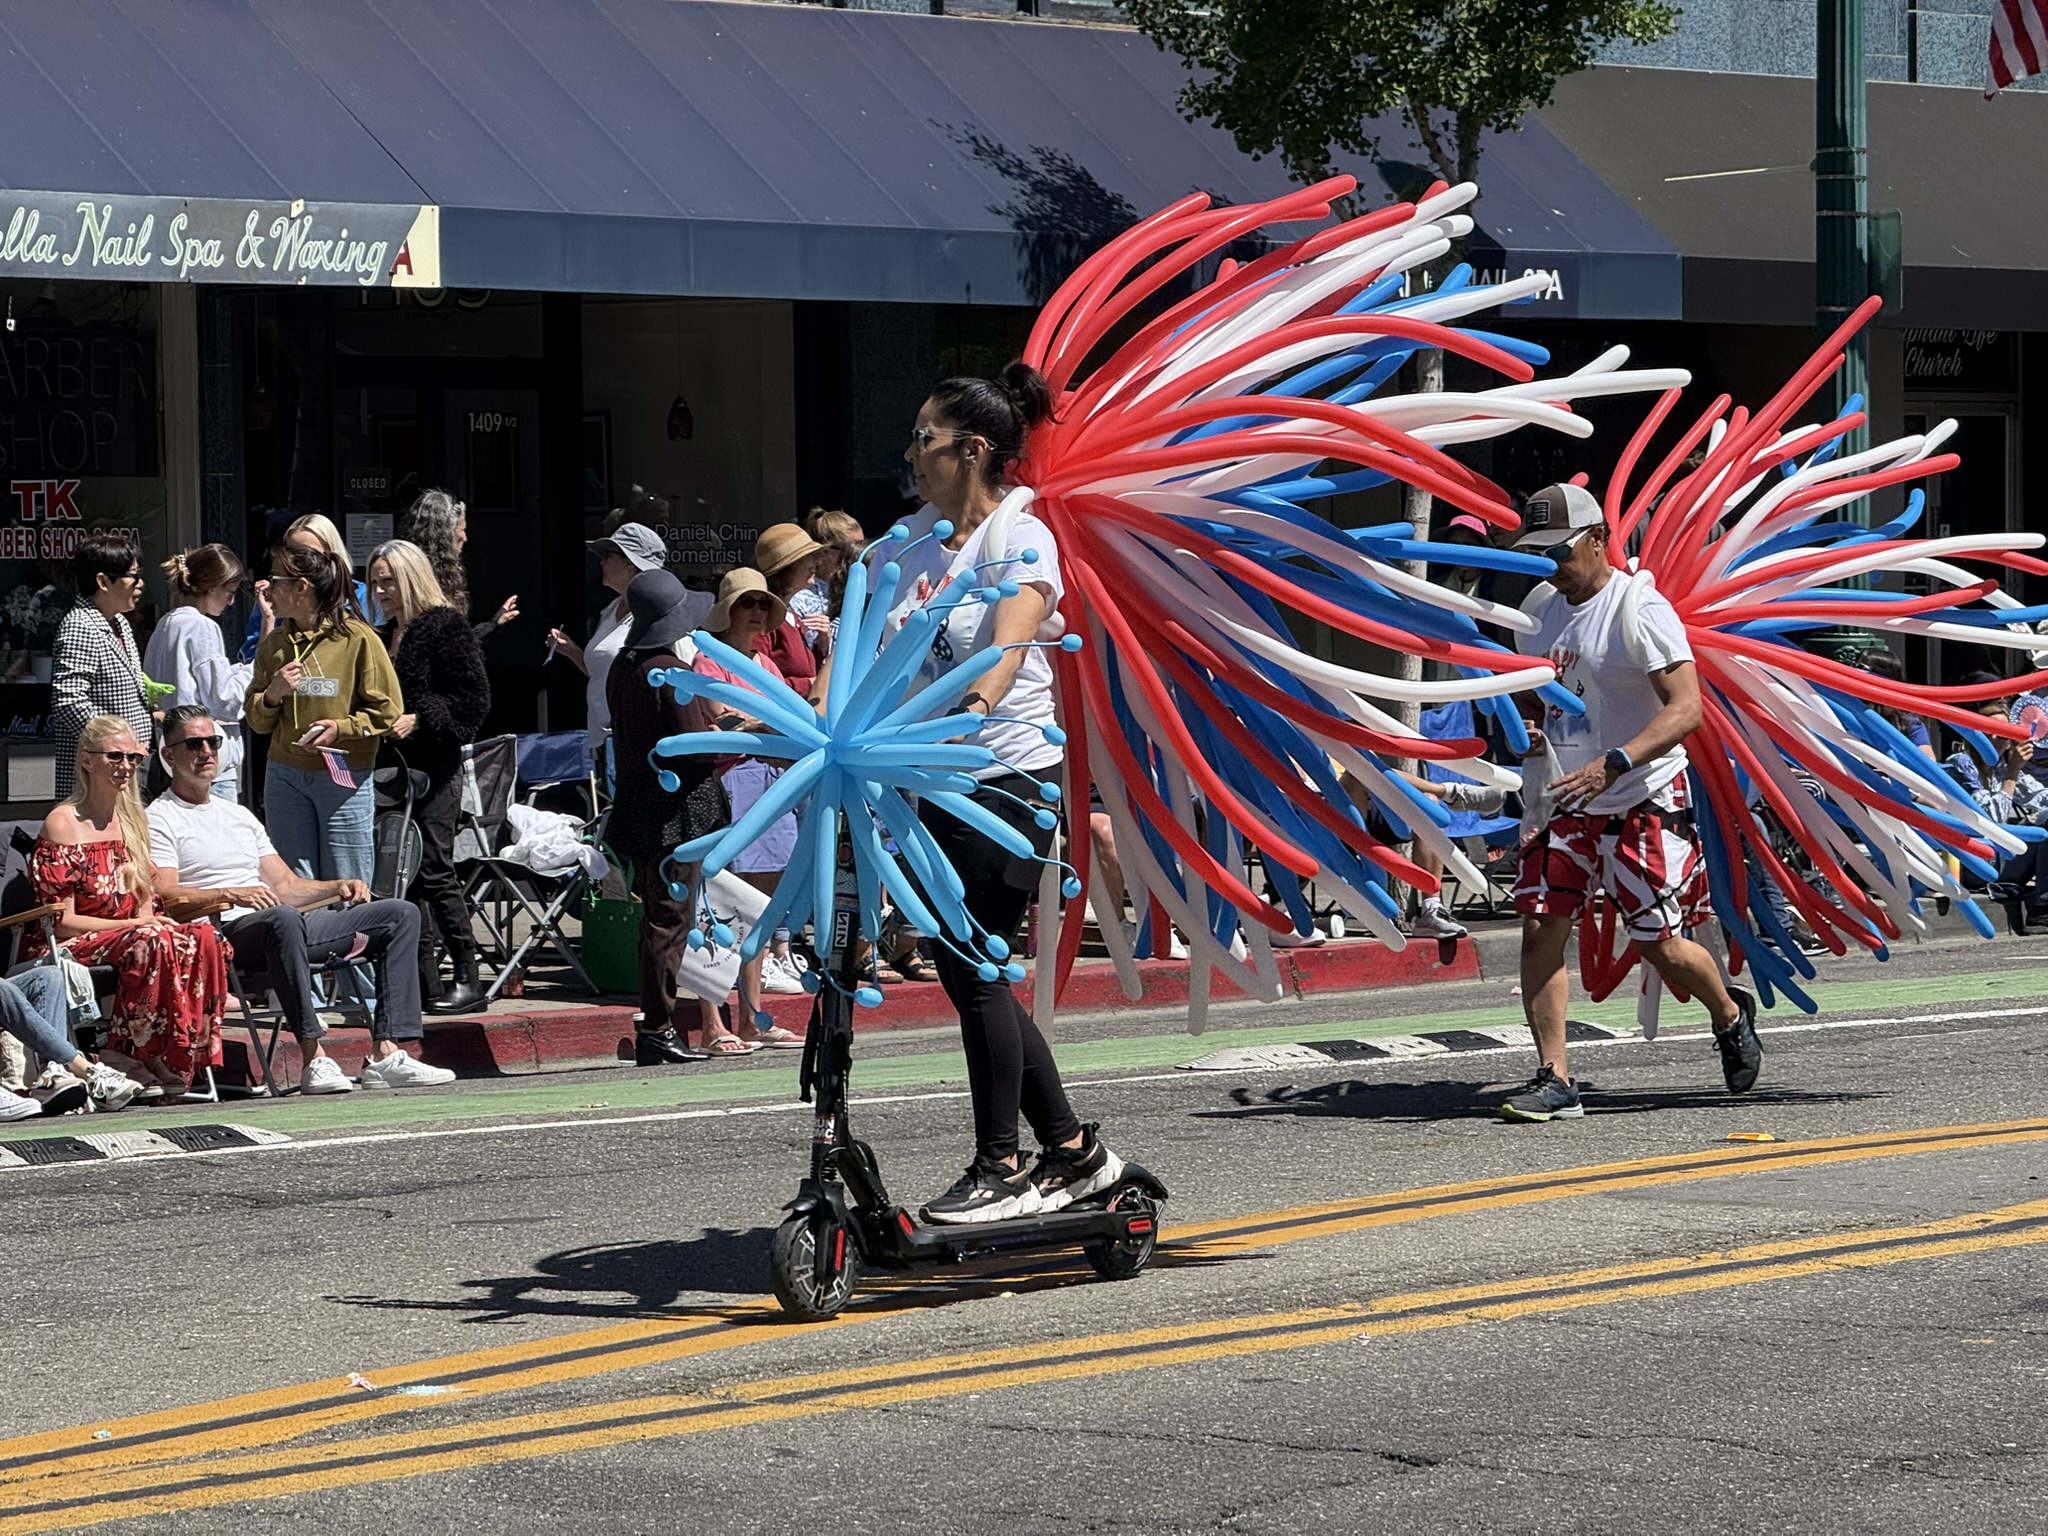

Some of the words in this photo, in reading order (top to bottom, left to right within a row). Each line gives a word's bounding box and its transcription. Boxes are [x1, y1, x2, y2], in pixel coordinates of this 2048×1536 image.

[0, 206, 59, 263] lla
[62, 202, 155, 267] Nail
[161, 213, 225, 279] Spa
[235, 209, 267, 269] &
[269, 214, 388, 286] Waxing
[1904, 346, 1965, 377] Church
[468, 412, 502, 433] 1409
[0, 409, 118, 472] HOP
[350, 478, 387, 489] CLOSED
[11, 479, 82, 521] TK
[0, 527, 37, 560] BER
[655, 523, 711, 542] Daniel
[719, 523, 759, 542] Chin
[665, 546, 743, 564] tometrist
[299, 676, 336, 696] das
